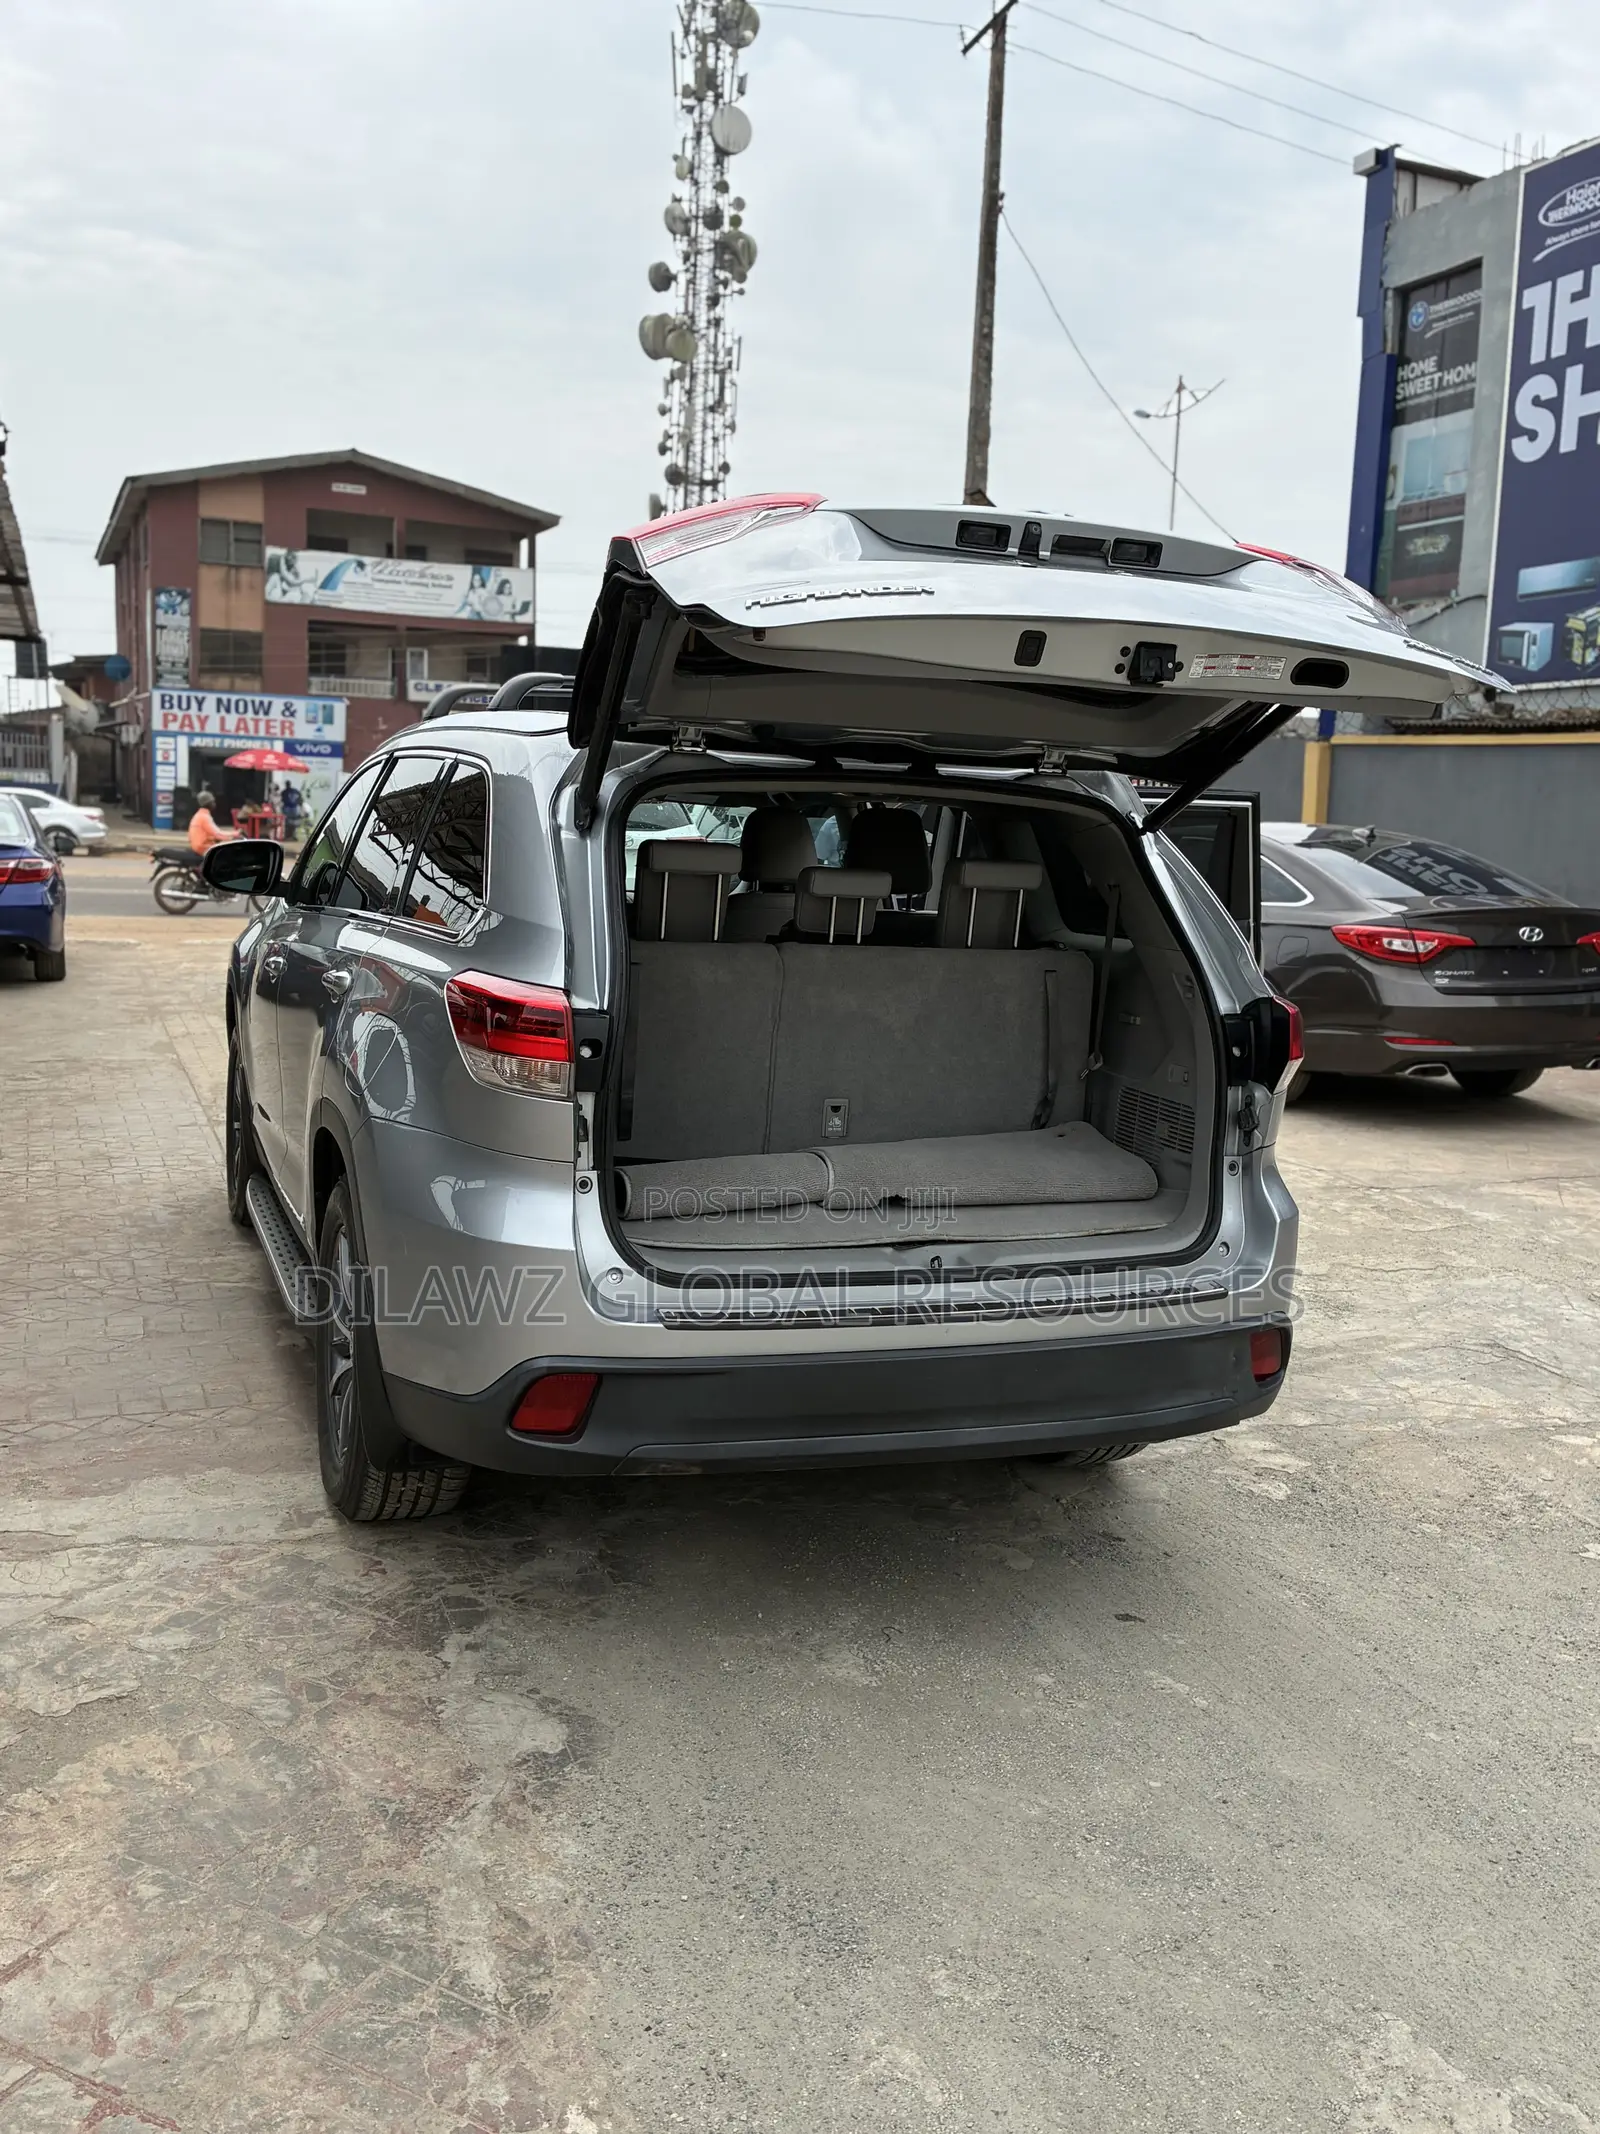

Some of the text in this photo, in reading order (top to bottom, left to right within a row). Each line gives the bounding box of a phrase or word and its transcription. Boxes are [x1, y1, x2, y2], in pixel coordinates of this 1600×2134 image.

[1397, 356, 1438, 382] HOME
[1396, 371, 1442, 400] SWEET
[745, 585, 936, 610] HIGHLANDER
[160, 693, 298, 718] BUY NOW &
[162, 712, 295, 737] PAY LATER
[190, 737, 222, 748] JUST
